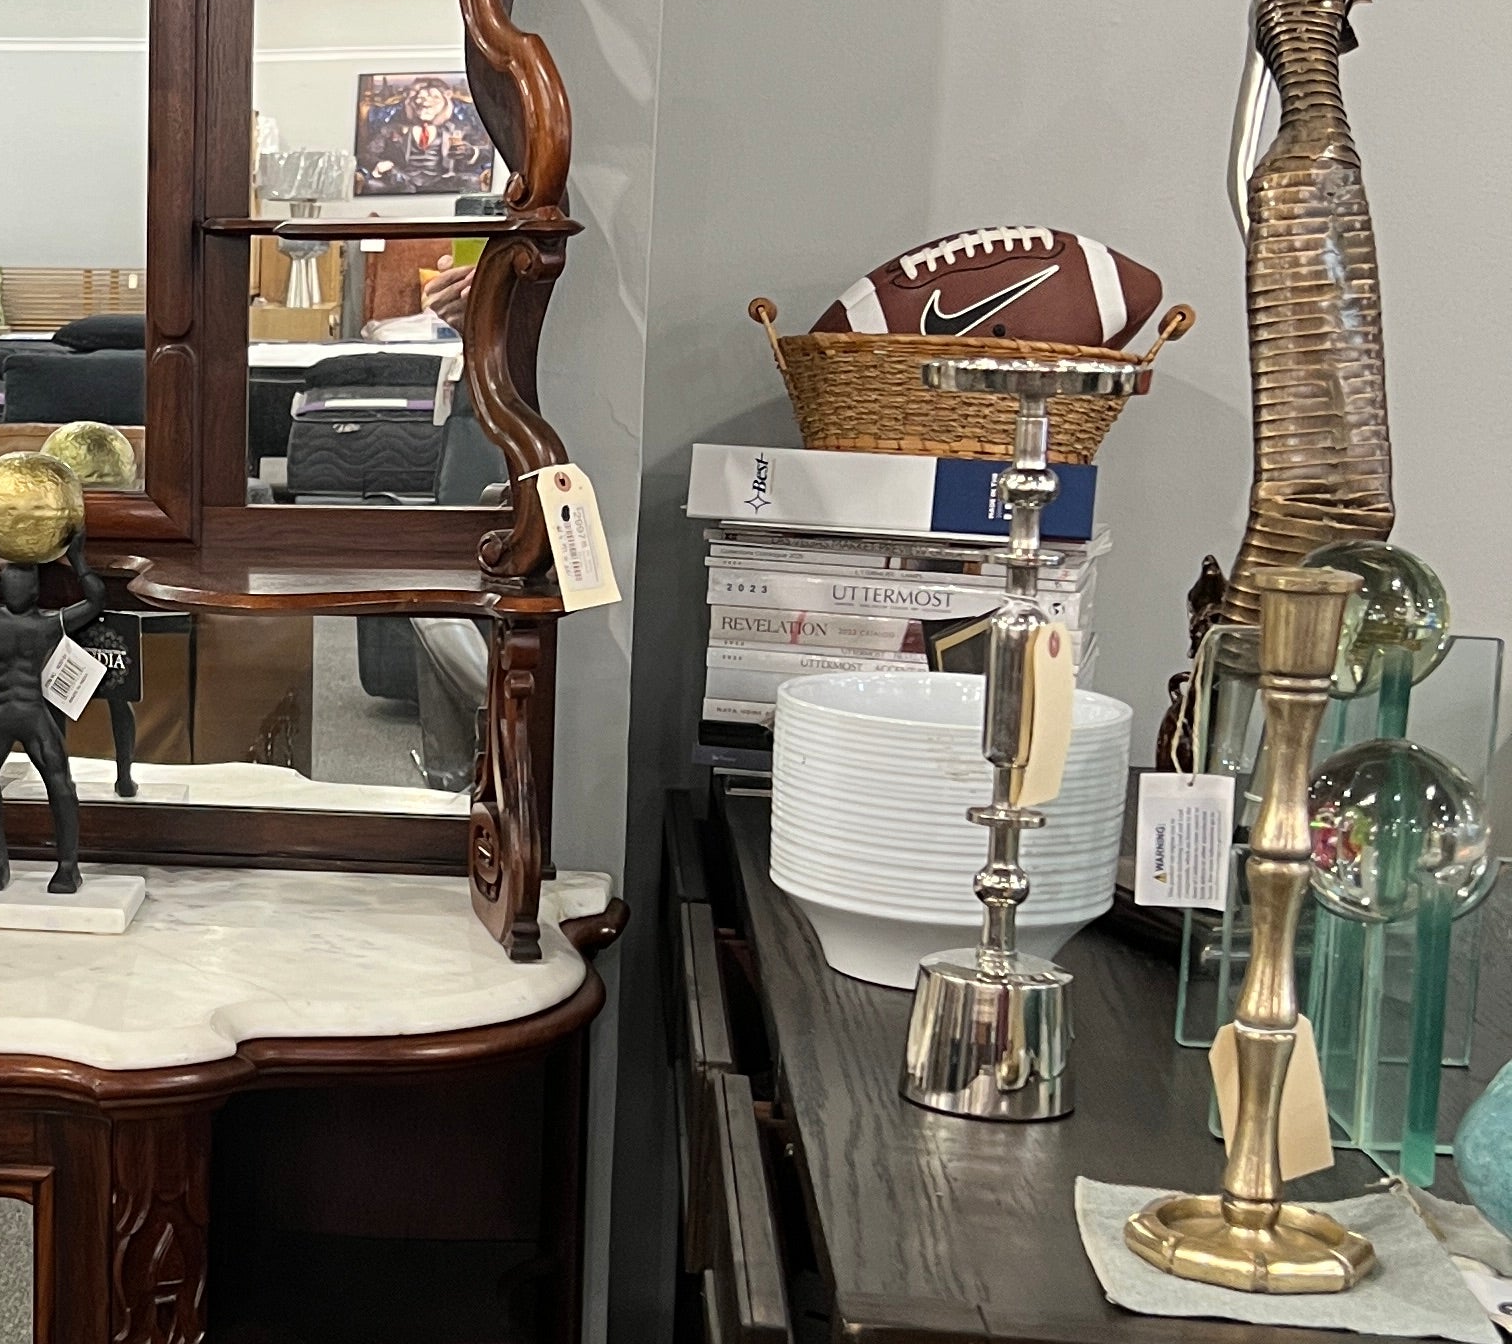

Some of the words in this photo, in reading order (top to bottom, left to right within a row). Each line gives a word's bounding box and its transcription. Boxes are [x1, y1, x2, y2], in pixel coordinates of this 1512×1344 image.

[751, 452, 769, 493] Best
[726, 583, 769, 594] 2023
[832, 584, 955, 608] UTTERMOST
[721, 615, 828, 636] REVELATION
